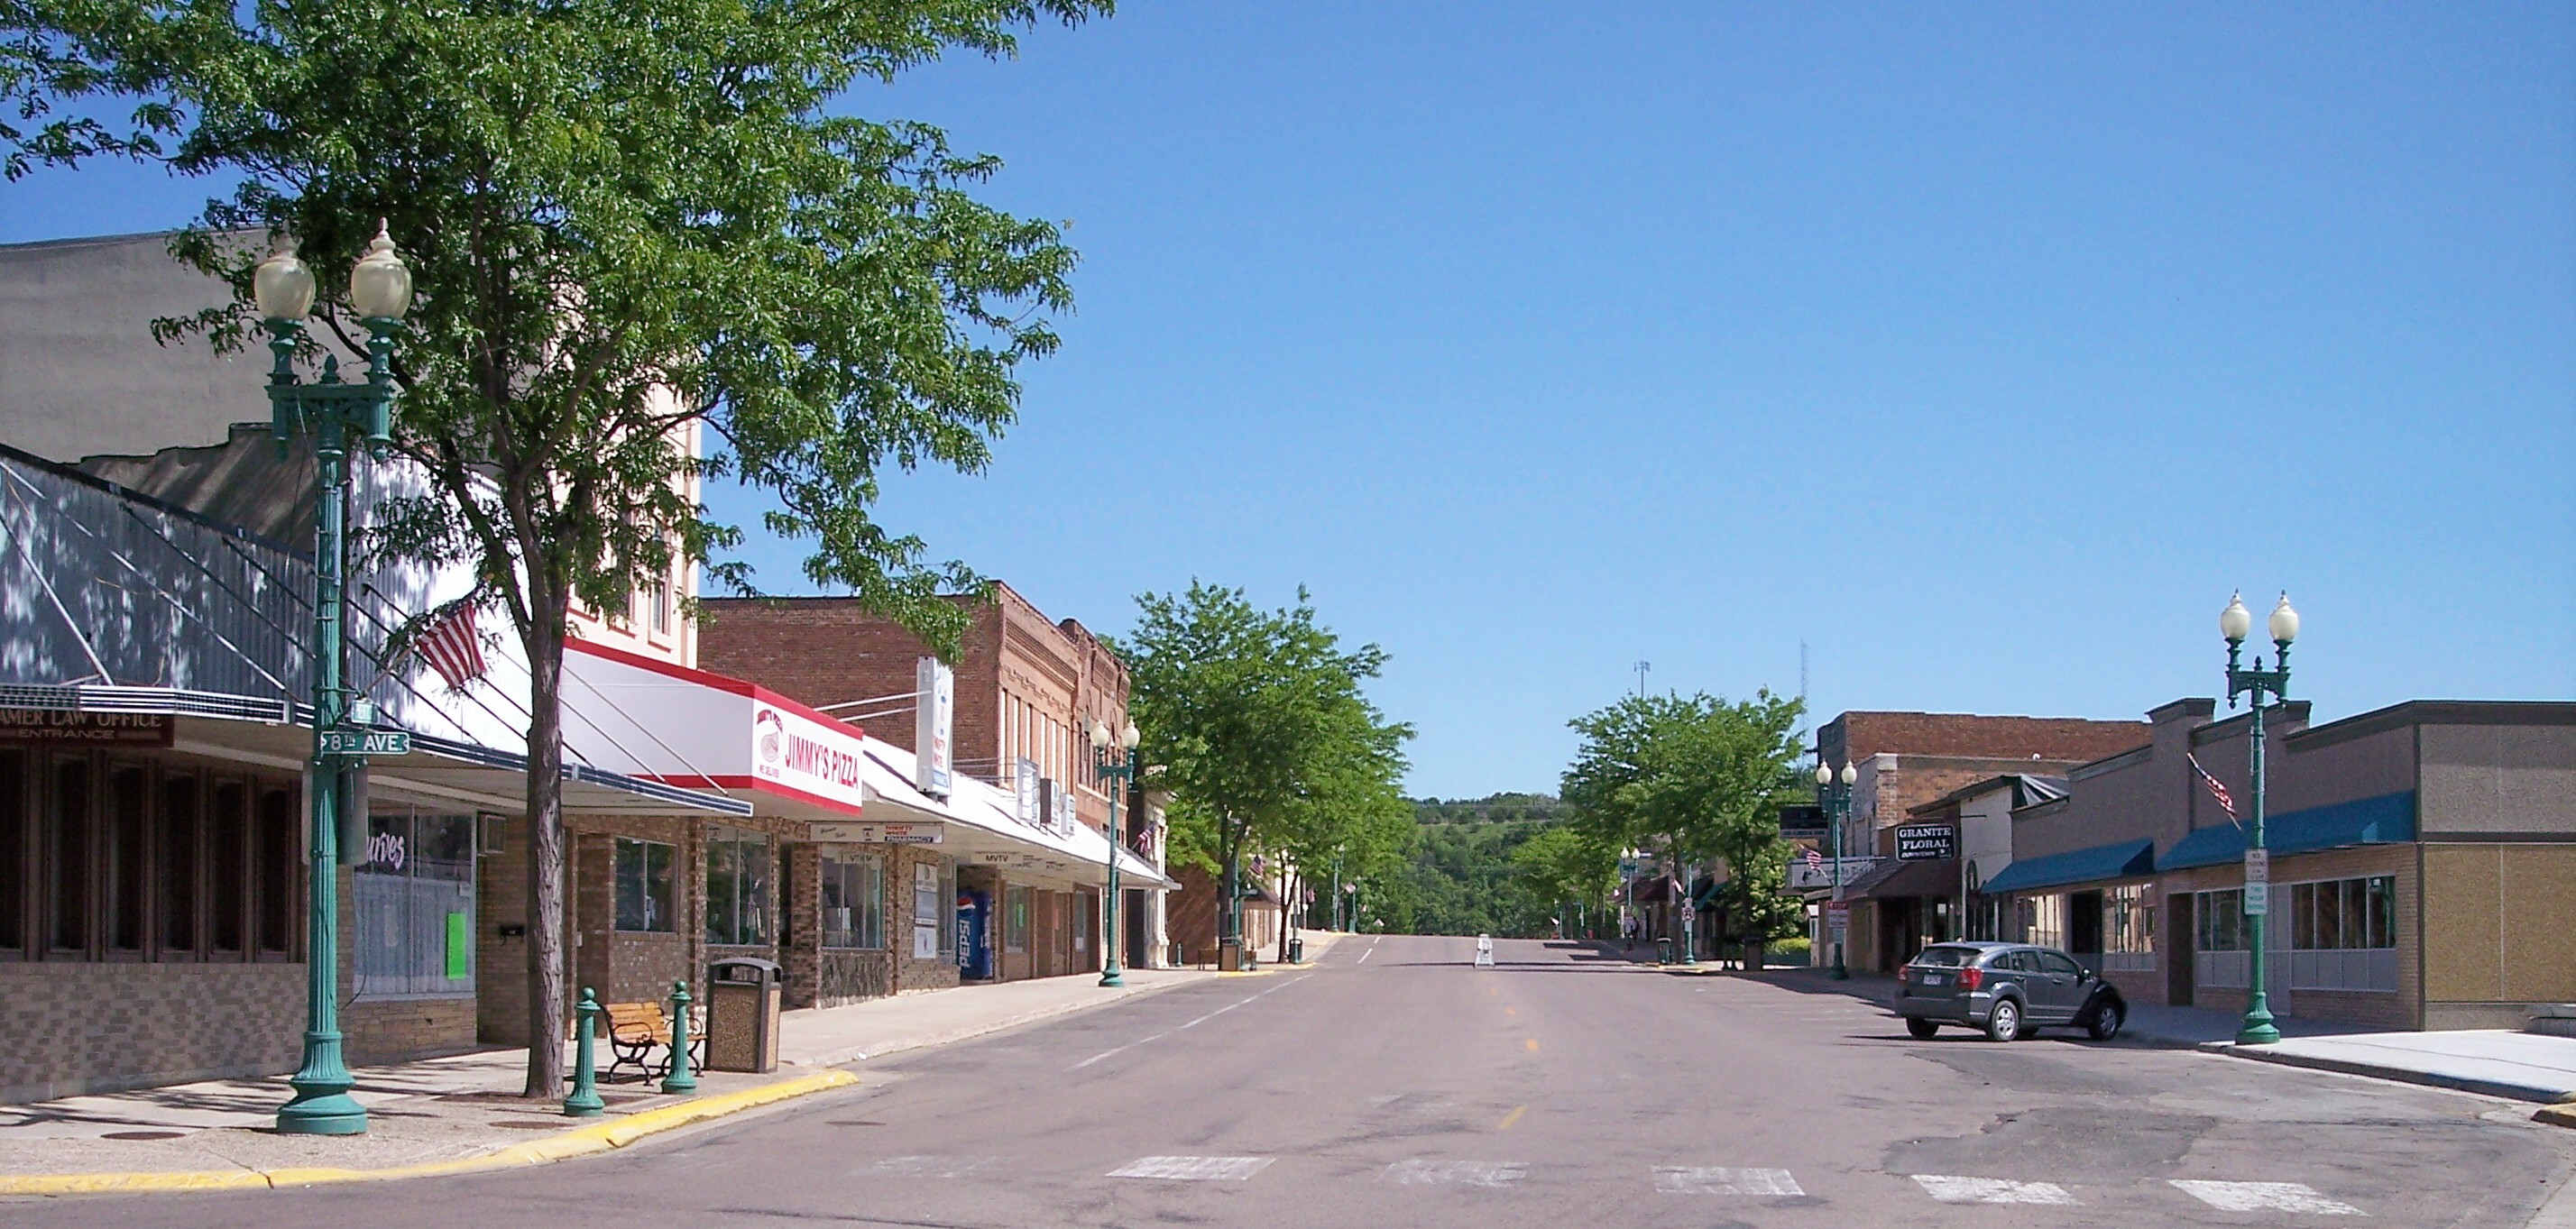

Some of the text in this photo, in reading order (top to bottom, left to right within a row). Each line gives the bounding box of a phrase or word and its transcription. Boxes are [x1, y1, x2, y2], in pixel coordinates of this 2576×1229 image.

[51, 711, 90, 726] LAW
[97, 713, 162, 728] OFFICE
[18, 729, 115, 739] ENTRANCE
[363, 735, 402, 751] AVE.
[786, 733, 859, 789] JIMMY'S PIZZA
[1899, 828, 1951, 838] GRANITE
[367, 831, 405, 870] urves
[1902, 839, 1950, 849] FLORAL
[959, 920, 971, 968] PEPSI
